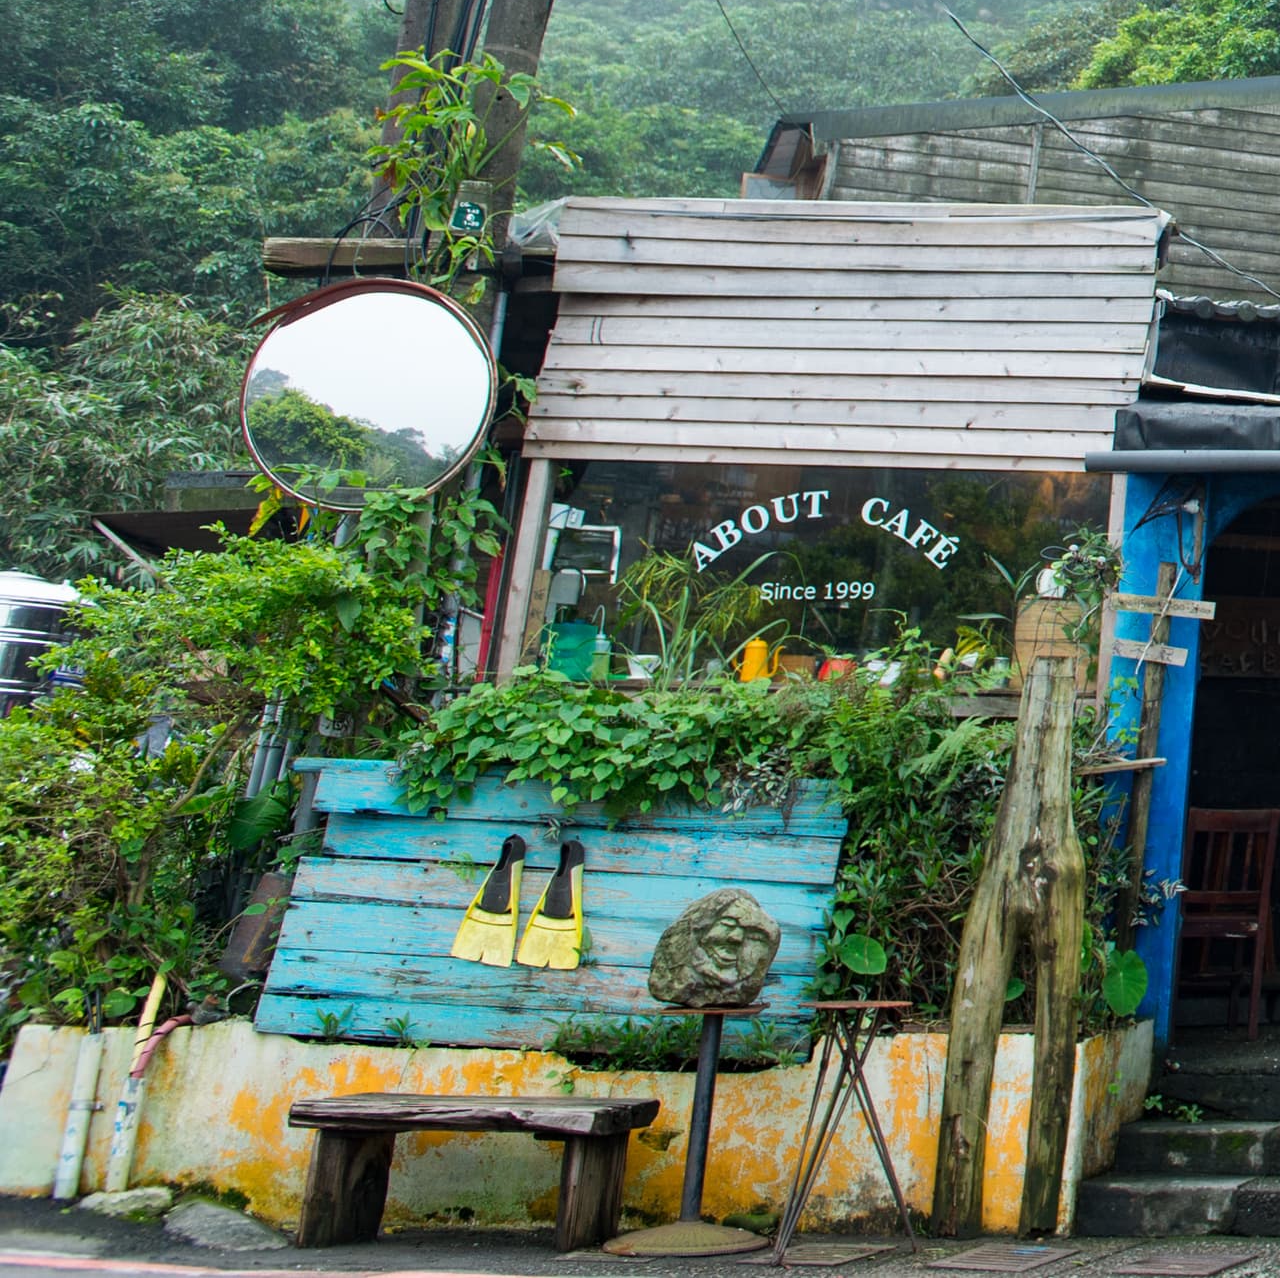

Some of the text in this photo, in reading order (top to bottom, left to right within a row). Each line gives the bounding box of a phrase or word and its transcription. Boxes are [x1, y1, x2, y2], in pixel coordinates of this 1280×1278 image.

[692, 490, 960, 572] ABOUT CAFÉ
[760, 582, 875, 600] Since 1999
